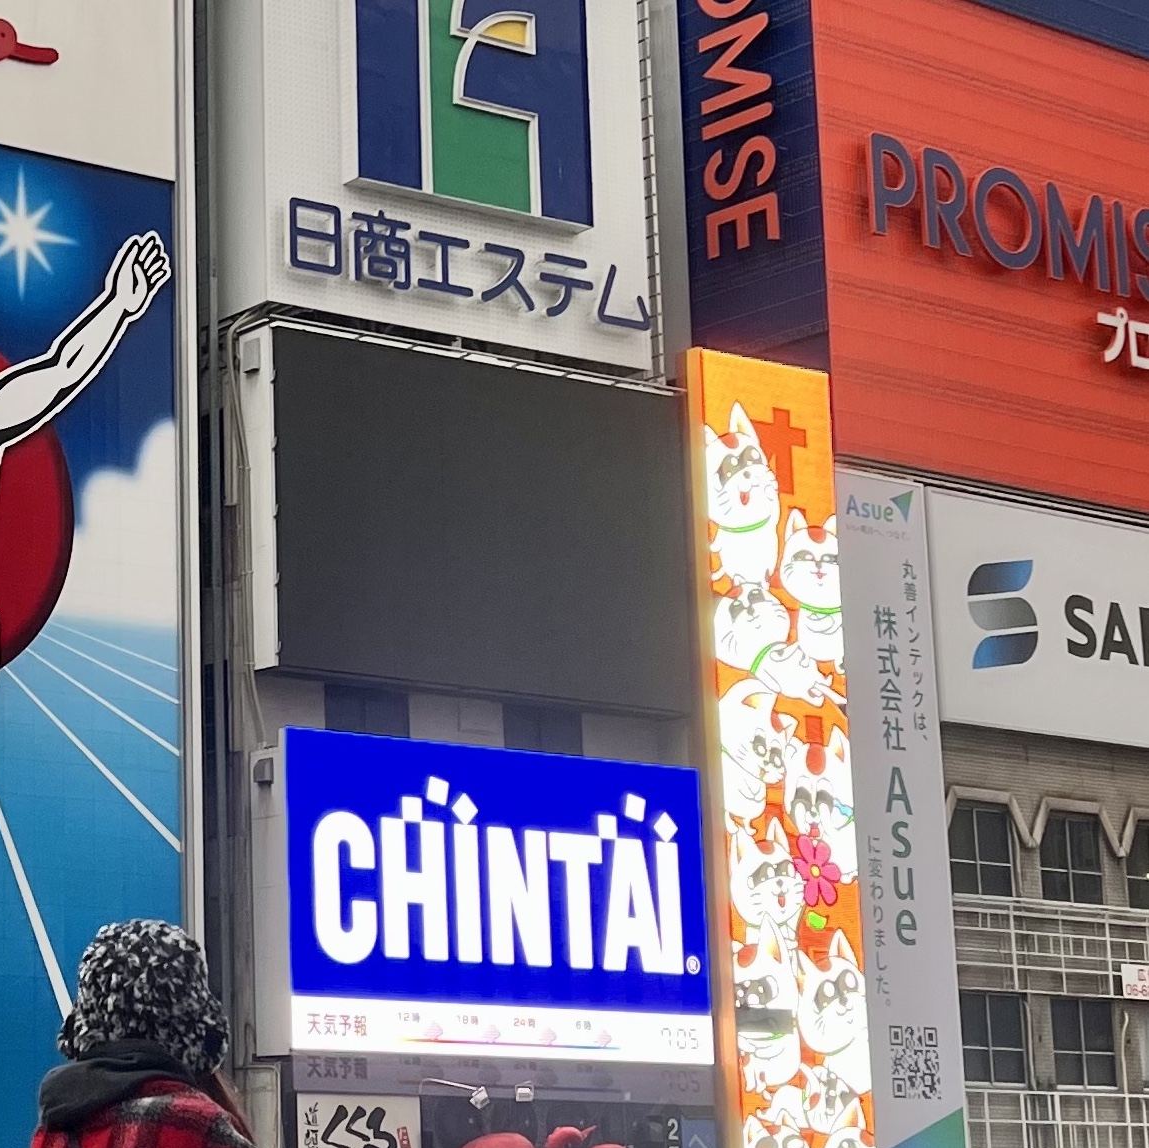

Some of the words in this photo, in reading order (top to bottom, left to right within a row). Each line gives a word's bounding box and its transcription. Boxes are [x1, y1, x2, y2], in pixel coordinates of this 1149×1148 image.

[289, 196, 650, 330] 日商エステム
[846, 494, 893, 522] Asue
[873, 604, 906, 752] 株式会社
[1064, 594, 1149, 667] SA
[313, 776, 685, 975] CHINTAI
[867, 834, 891, 1008] に変わりました。
[885, 766, 917, 946] Asue
[307, 1012, 368, 1038] 天気予報
